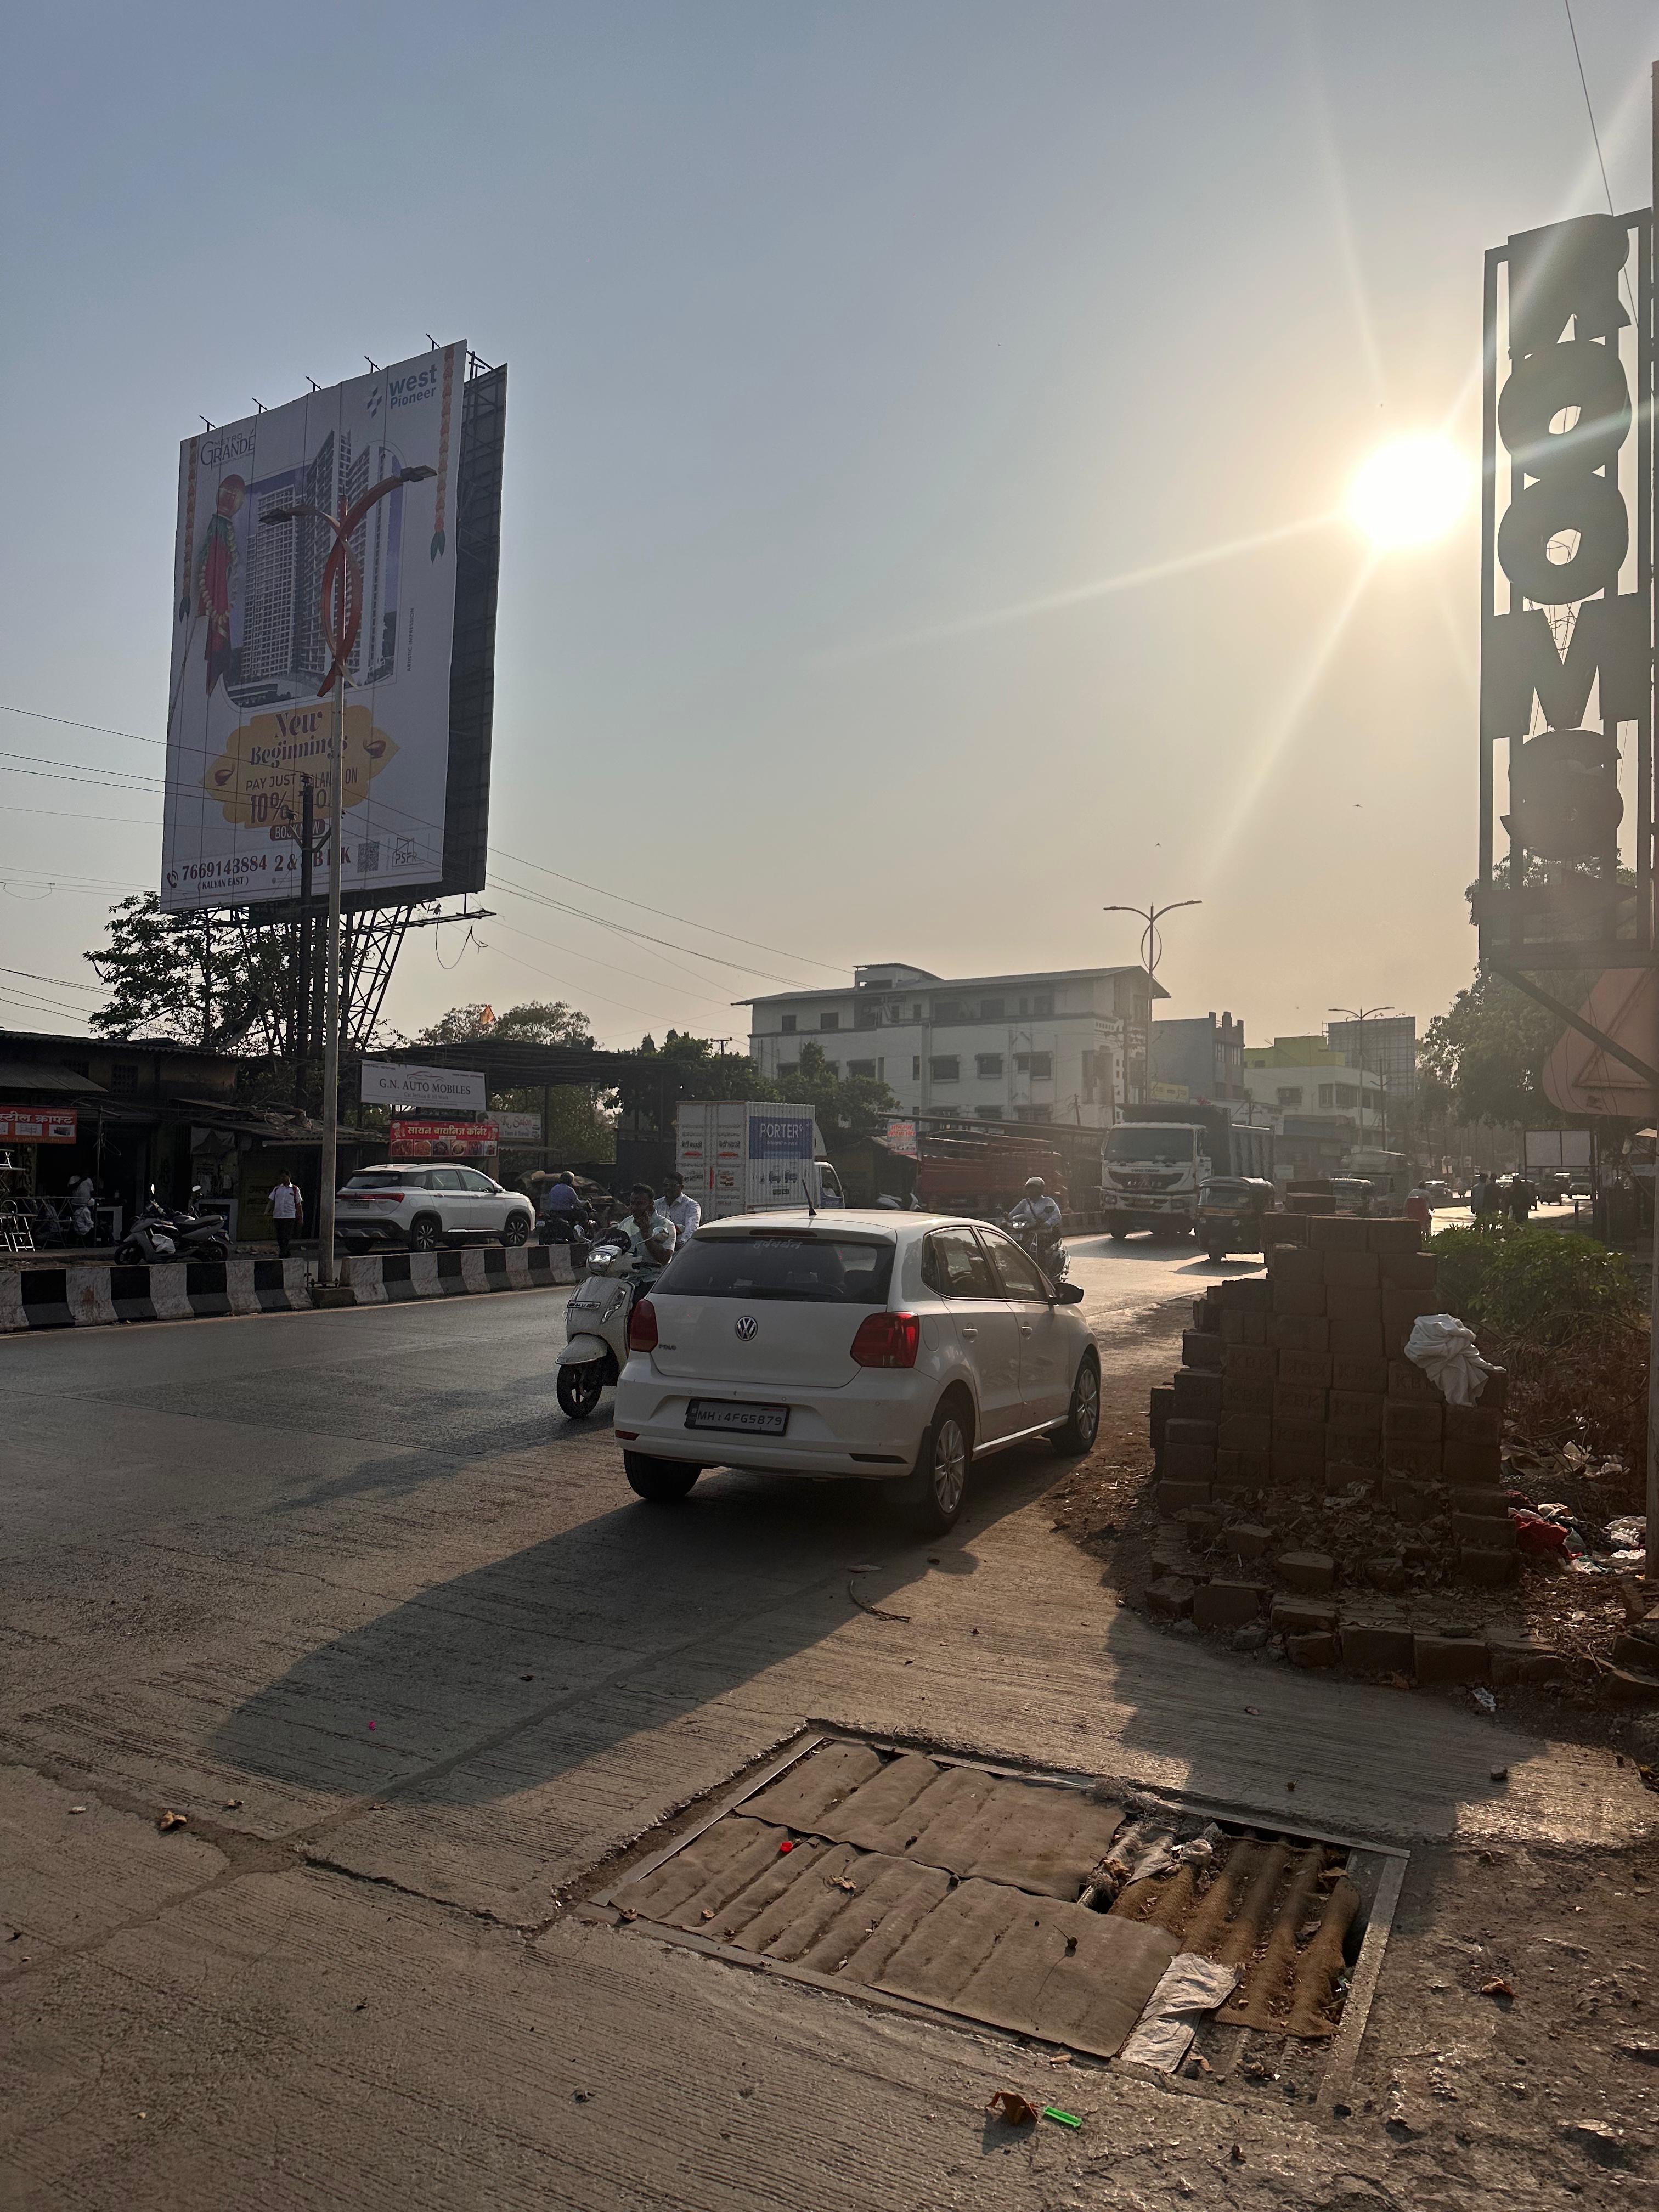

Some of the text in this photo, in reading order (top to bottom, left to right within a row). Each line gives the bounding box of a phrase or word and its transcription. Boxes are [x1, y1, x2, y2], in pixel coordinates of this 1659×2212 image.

[389, 364, 437, 397] west
[390, 387, 436, 409] Pioneer
[214, 432, 242, 447] METRO
[1481, 213, 1649, 860] ROOMS
[274, 710, 323, 738] New
[246, 773, 297, 791] PAY JUST
[250, 791, 290, 823] 10%
[182, 854, 267, 881] 7669143884
[274, 855, 283, 872] 2
[287, 853, 297, 870] &
[379, 1078, 471, 1095] G.N. AUTO MOBILES
[760, 1123, 799, 1138] PORTER
